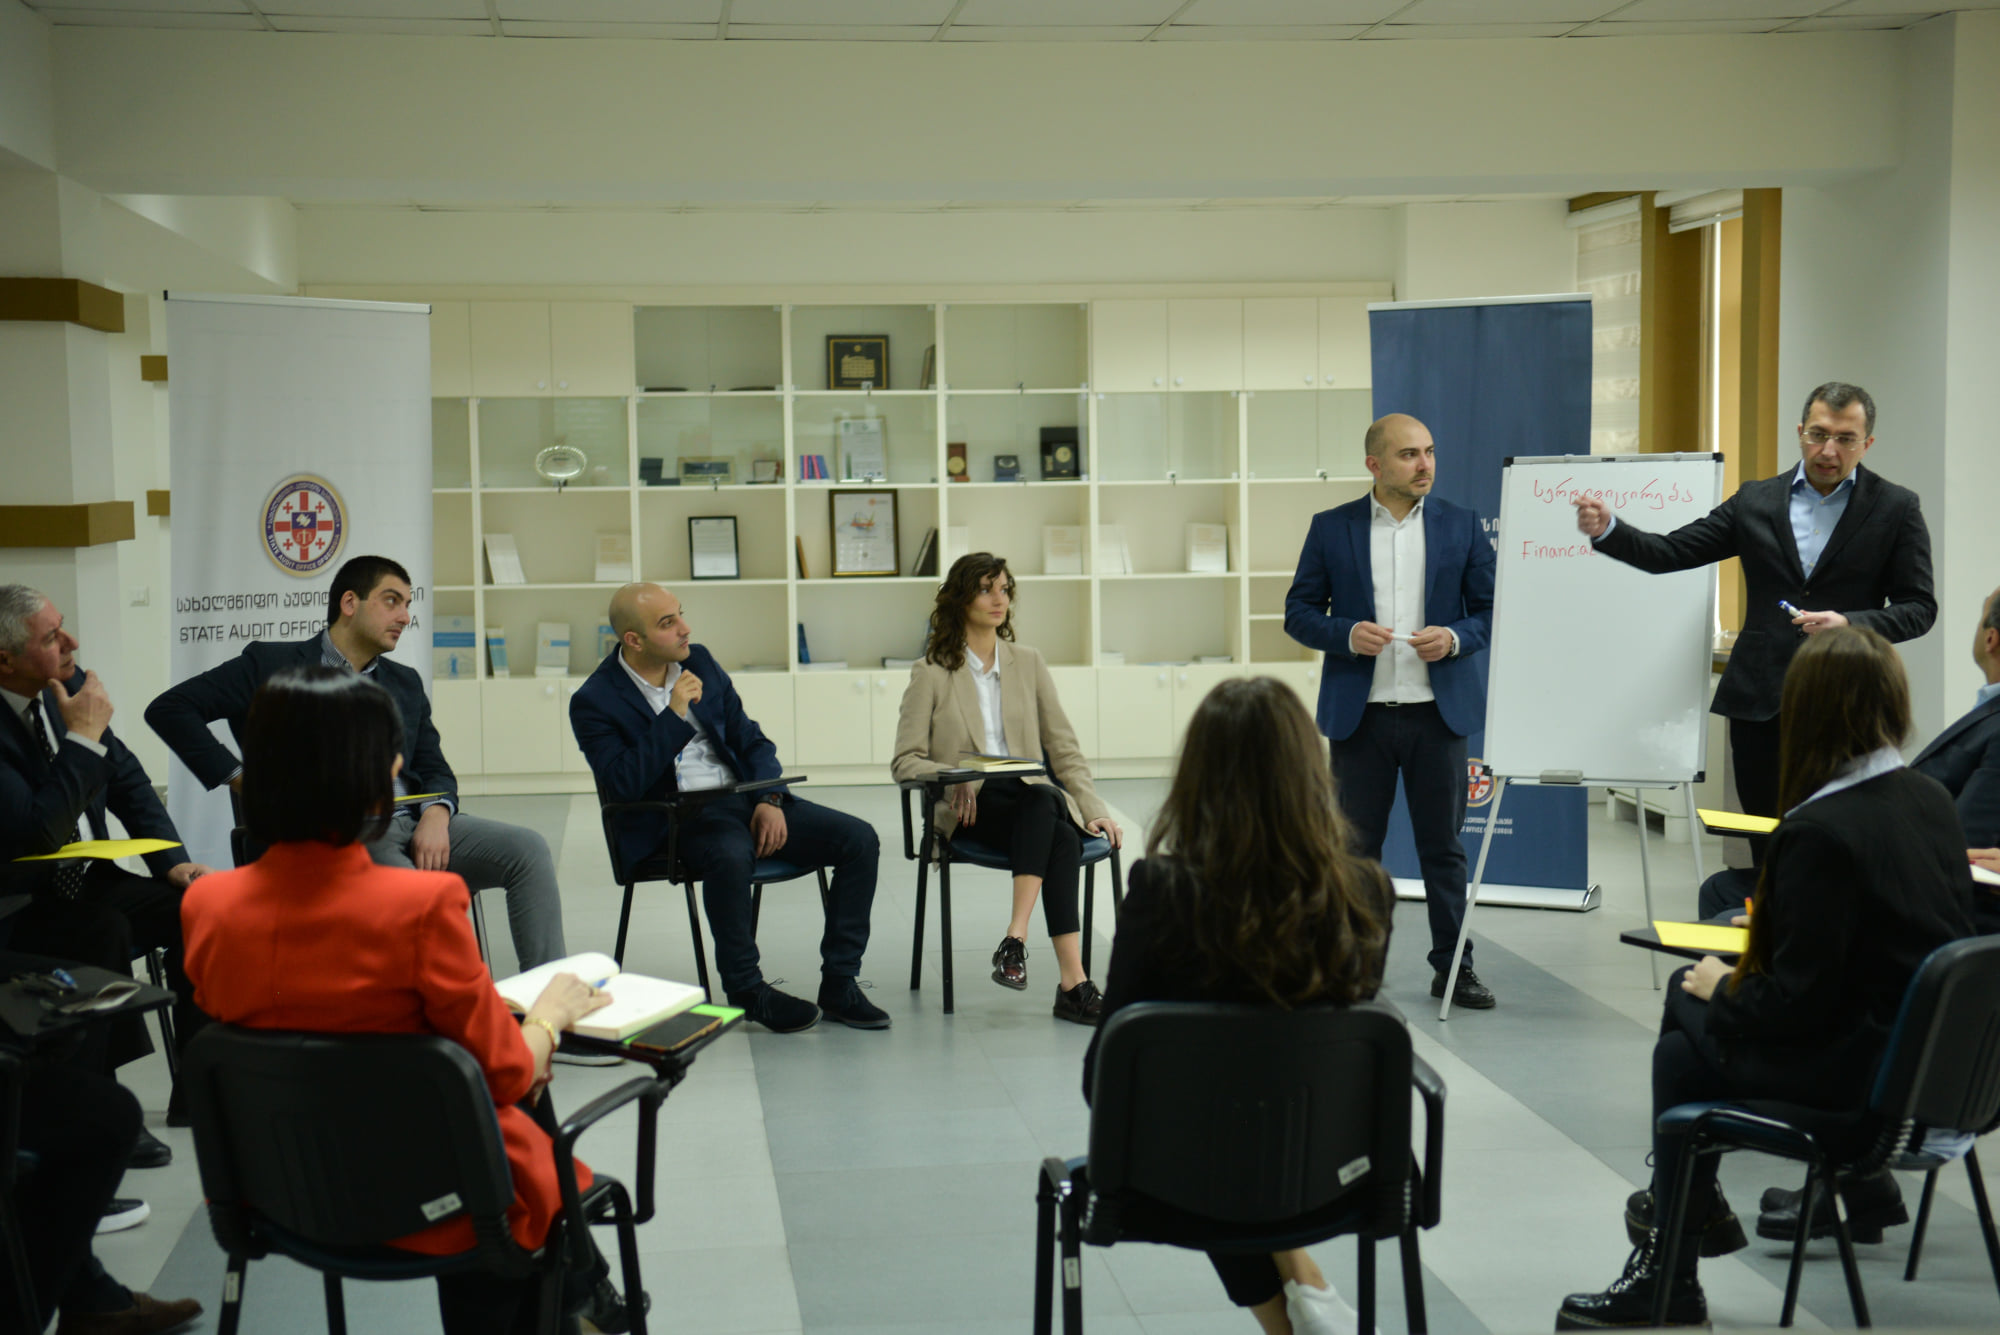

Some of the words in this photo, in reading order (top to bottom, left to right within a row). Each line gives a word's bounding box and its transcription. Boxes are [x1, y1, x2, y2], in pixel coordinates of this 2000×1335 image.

[176, 592, 278, 613] სახელმწიფო
[180, 625, 224, 643] STATE
[228, 622, 275, 640] AUDIT
